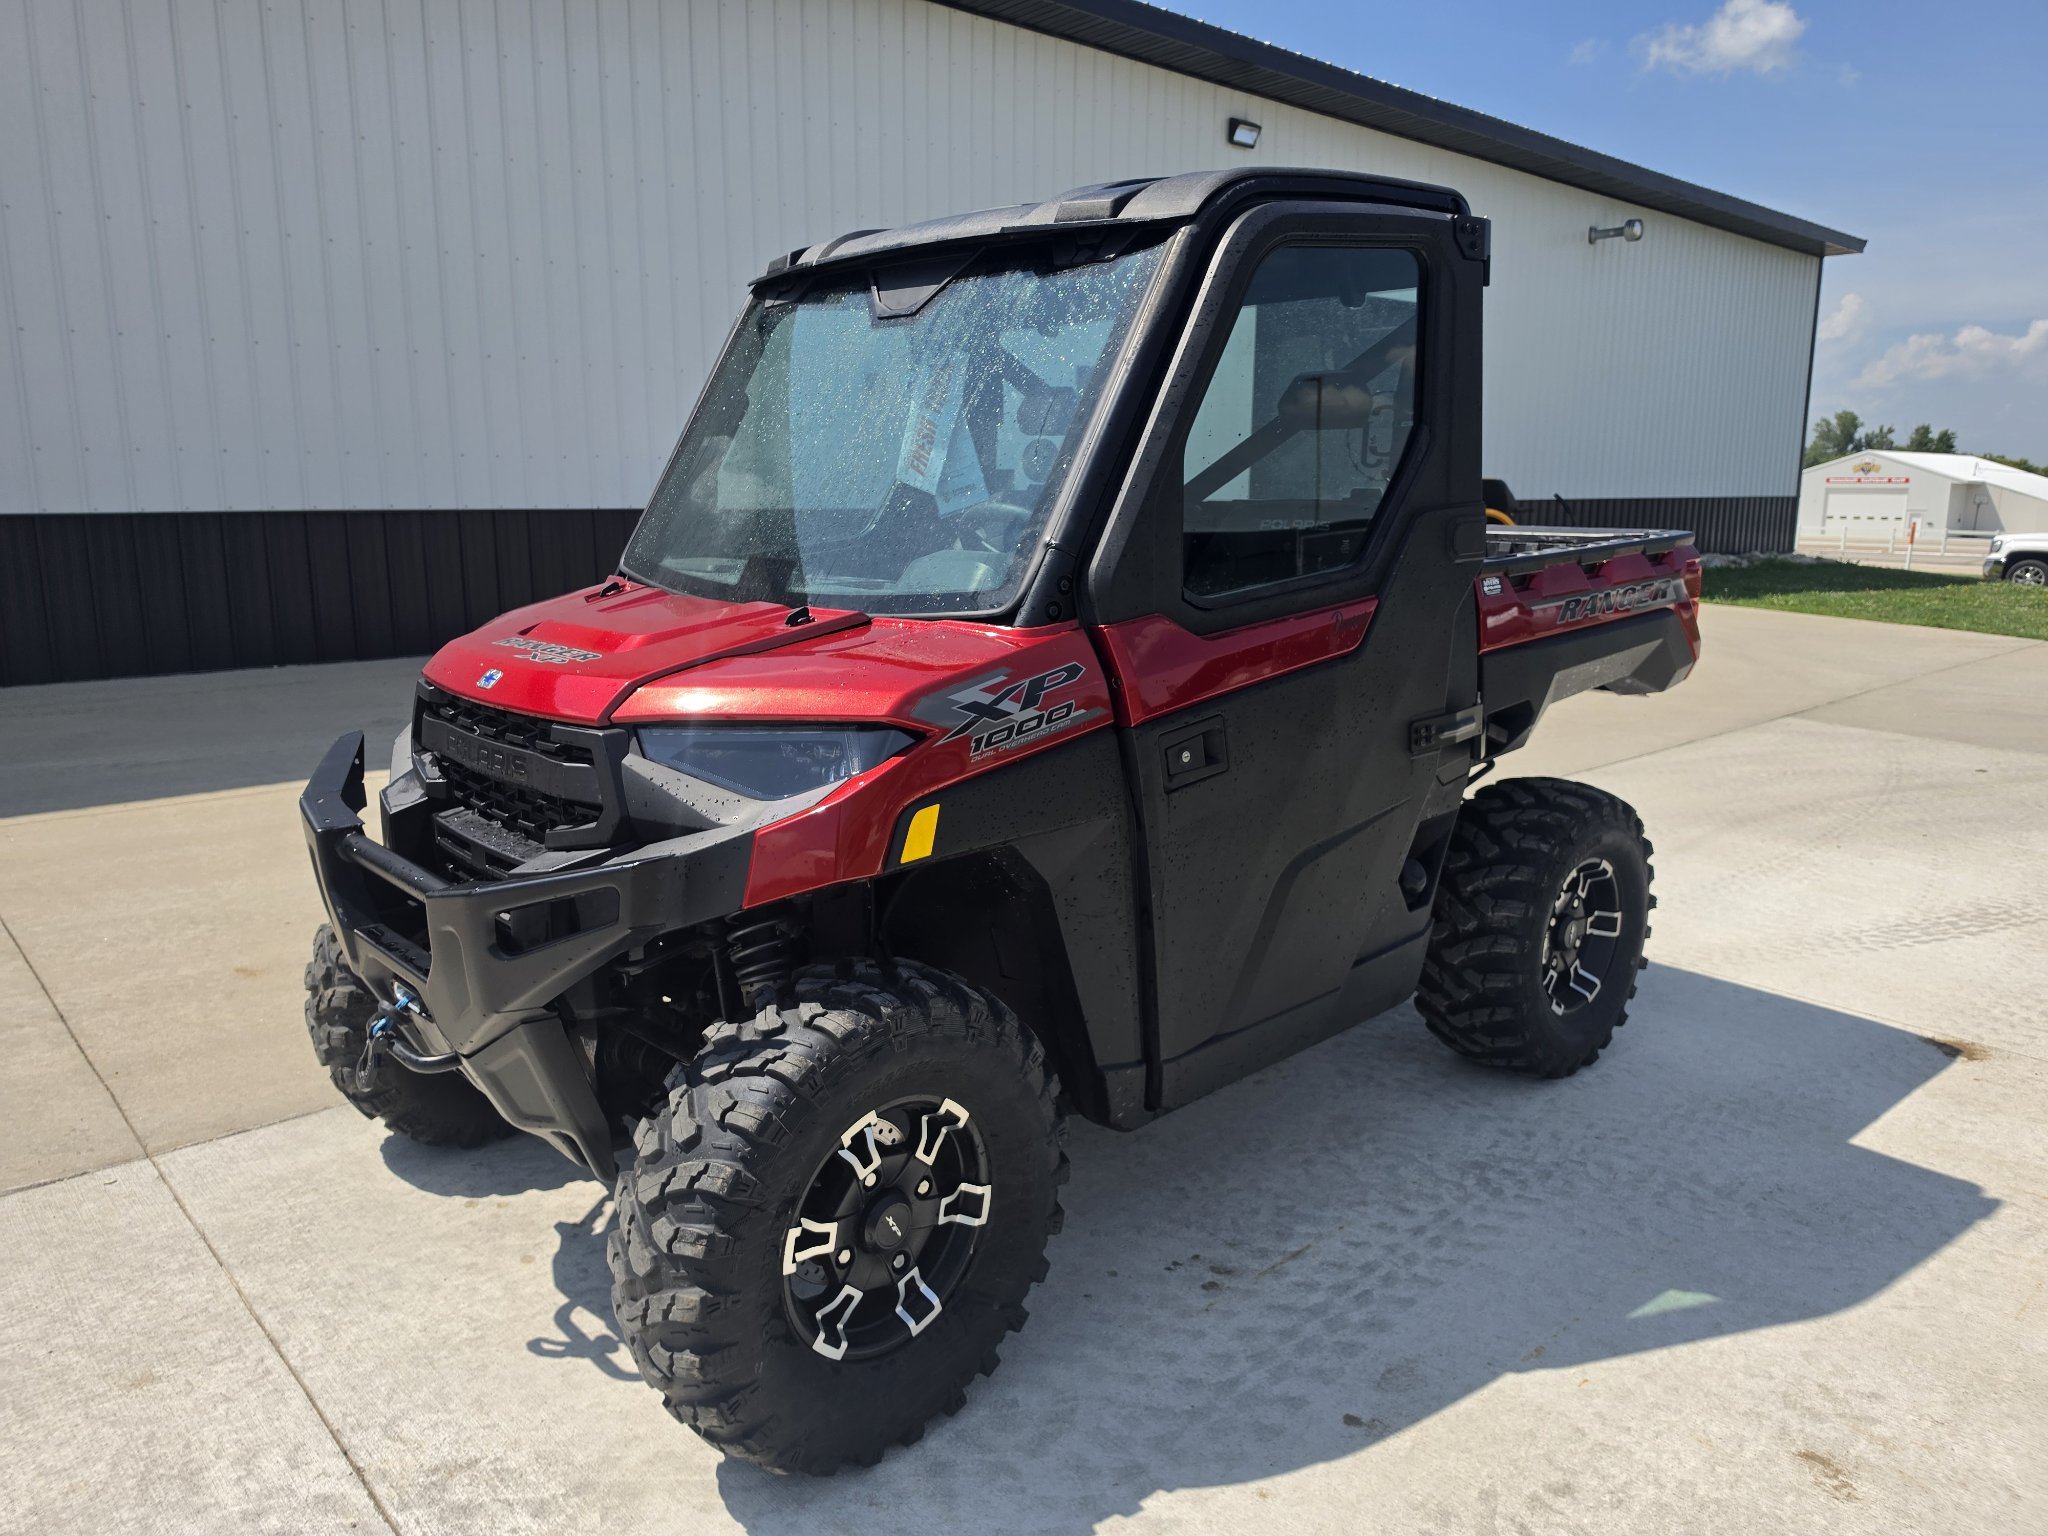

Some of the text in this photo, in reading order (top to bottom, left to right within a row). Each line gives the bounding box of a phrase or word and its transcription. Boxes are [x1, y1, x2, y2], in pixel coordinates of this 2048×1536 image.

[910, 415, 938, 478] FRESH
[1259, 519, 1331, 531] POLARIS
[1557, 578, 1672, 624] RANGER
[491, 637, 603, 662] RANGER
[512, 652, 569, 664] XP
[932, 661, 1087, 748] XP
[970, 699, 1076, 757] 1000
[970, 719, 1072, 763] DUAL OVERHEAD CAM
[885, 1215, 902, 1237] XP
